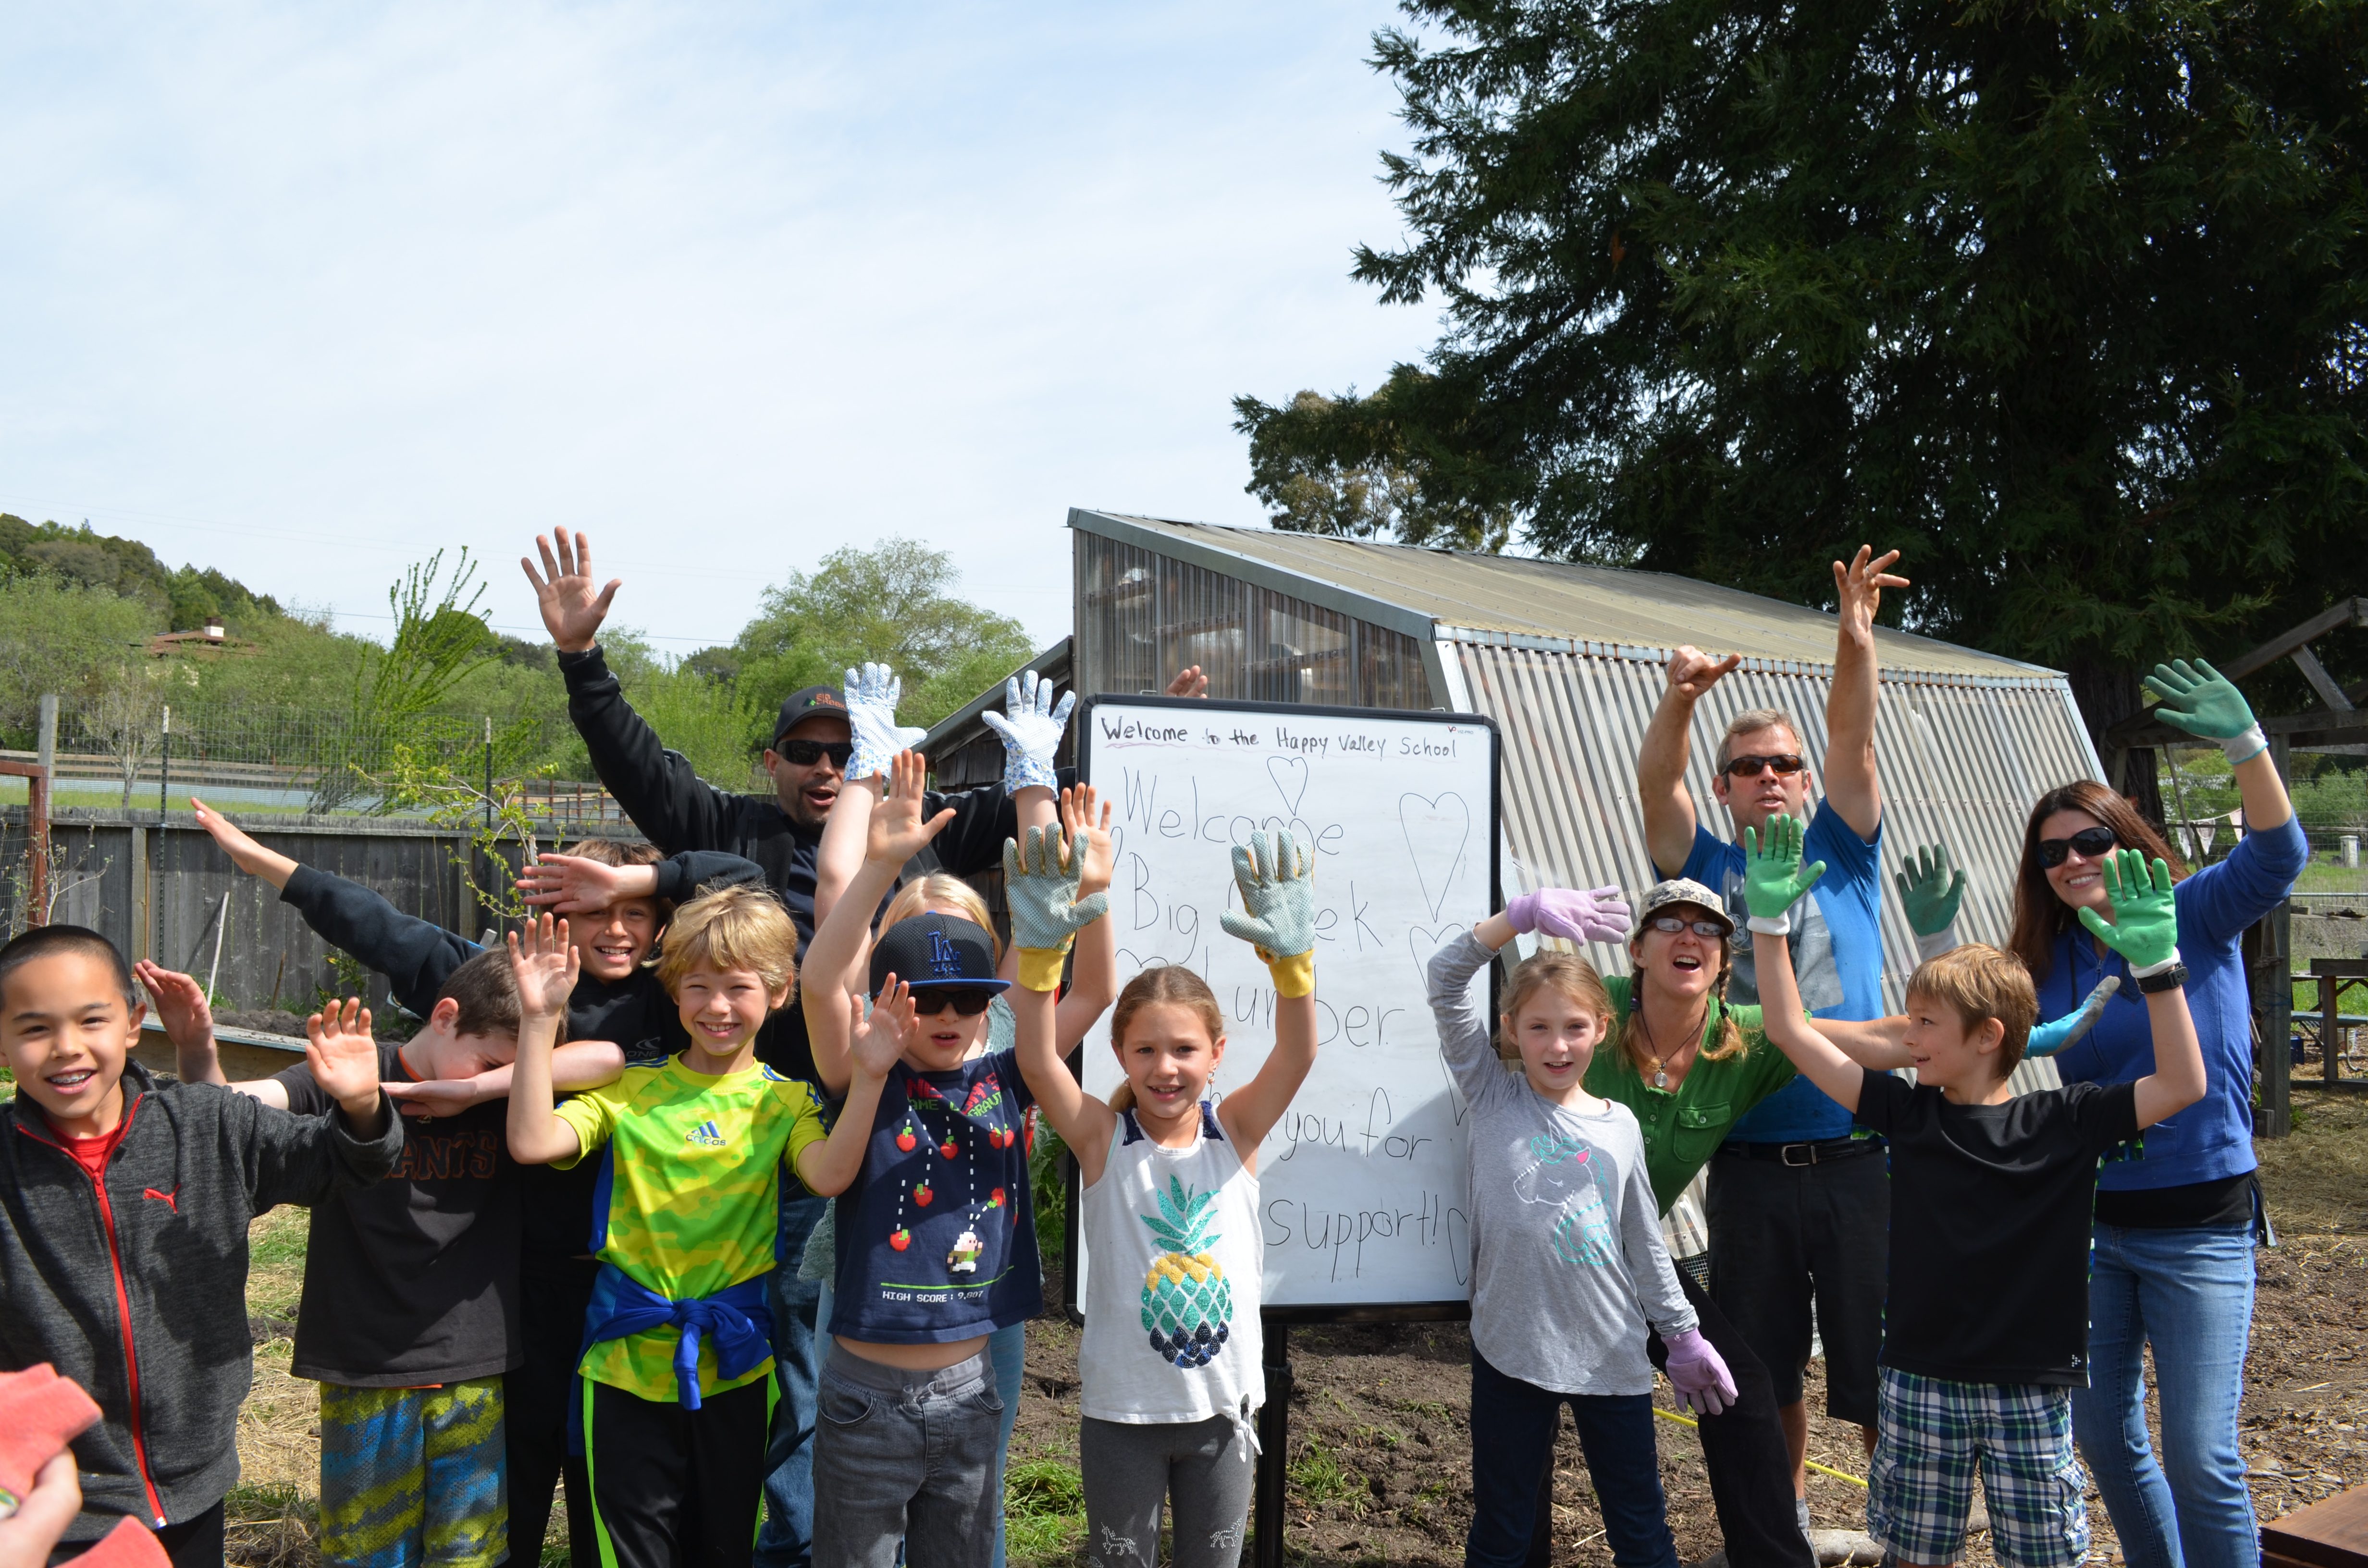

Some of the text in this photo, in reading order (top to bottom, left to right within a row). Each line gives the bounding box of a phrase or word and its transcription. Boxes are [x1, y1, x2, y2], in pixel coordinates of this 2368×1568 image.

[1101, 715, 1456, 761] Welcome to the Happy Valley School
[1129, 852, 1198, 964] Big
[927, 931, 962, 975] LA
[908, 1097, 939, 1111] AME
[1280, 1111, 1345, 1161] you
[1359, 1087, 1432, 1161] for
[383, 1129, 498, 1180] ANTS
[686, 1134, 727, 1146] adidas
[882, 1291, 911, 1302] HIGH
